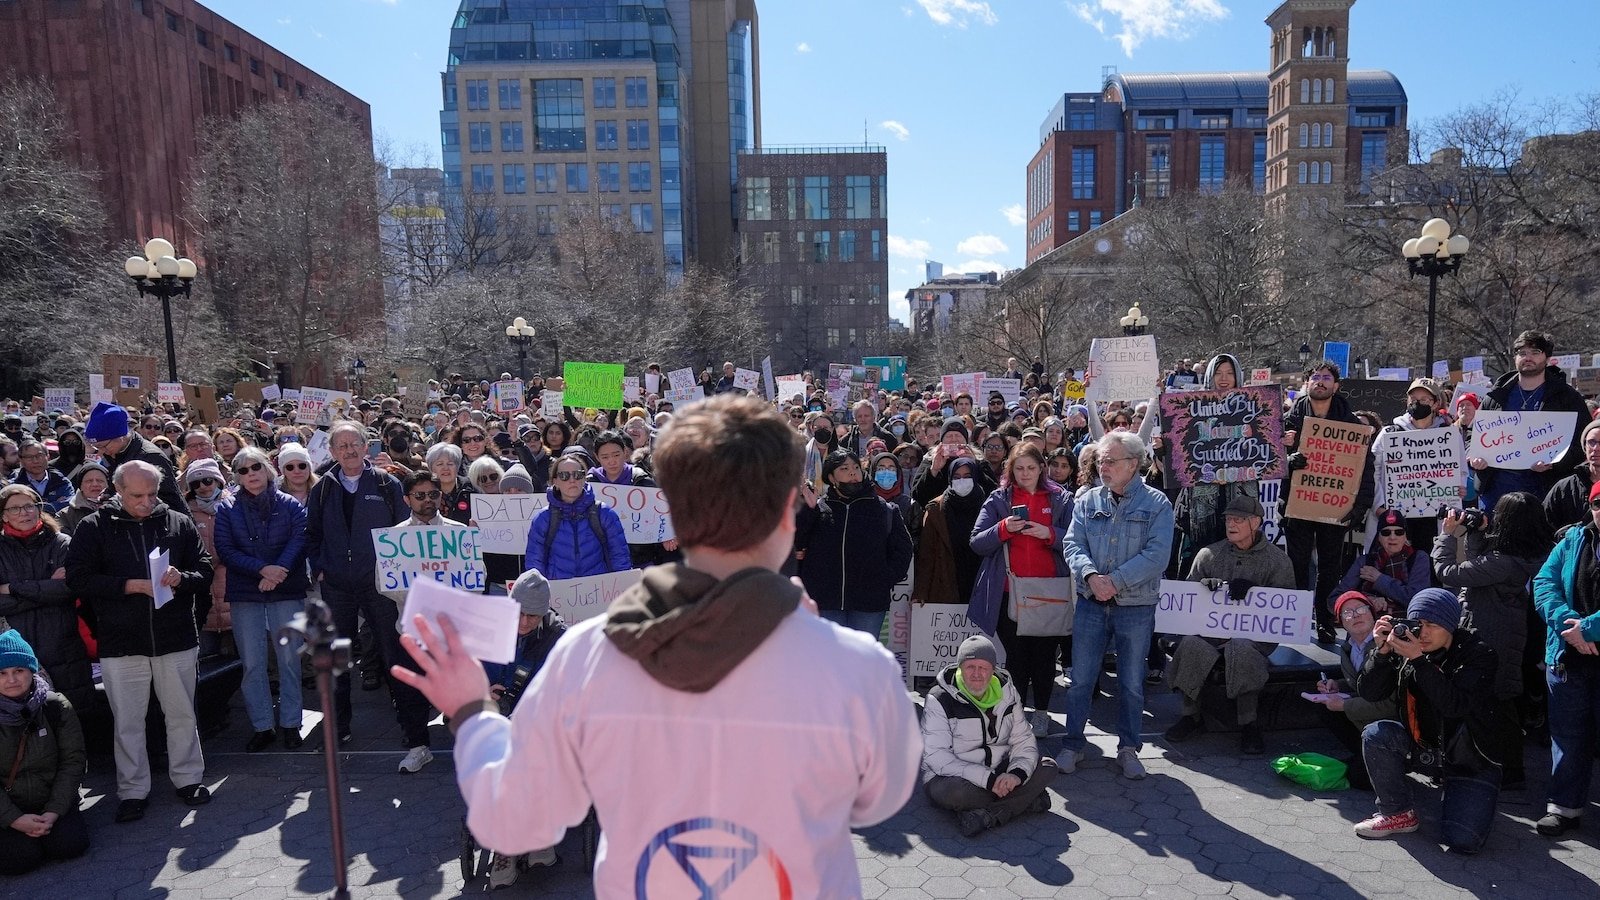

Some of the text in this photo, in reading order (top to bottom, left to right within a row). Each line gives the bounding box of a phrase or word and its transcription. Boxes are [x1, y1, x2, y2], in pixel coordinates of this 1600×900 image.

[1100, 350, 1152, 362] SCIENCE
[218, 401, 240, 411] FUND
[302, 400, 323, 410] NOT
[503, 400, 516, 408] NIH
[1188, 391, 1264, 423] United By
[1193, 417, 1253, 442] Nature
[1474, 411, 1522, 433] (Funding)
[1312, 423, 1320, 436] 9
[1323, 426, 1347, 441] OUT
[1347, 430, 1361, 443] OF
[1389, 436, 1399, 448] I
[1437, 431, 1452, 445] of
[1480, 421, 1554, 448] Cuts don't
[1188, 437, 1278, 470] Guided By
[1306, 437, 1361, 455] PREVENT
[1386, 446, 1452, 461] NO time in
[1495, 434, 1564, 464] cure cancer
[1198, 462, 1264, 484] Science
[1385, 460, 1460, 475] human where
[1396, 468, 1455, 482] IGNORANCE
[1300, 473, 1345, 490] PREFER
[1397, 481, 1423, 490] was
[1295, 489, 1350, 508] THE GOP
[1396, 485, 1461, 500] KNOWLEDGE
[475, 497, 543, 520] DATA
[377, 529, 484, 561] SCIENCE
[421, 560, 451, 572] NOT
[385, 570, 486, 590] SIENCE
[567, 582, 600, 608] Just
[1158, 592, 1198, 613] ONT
[931, 612, 968, 628] IF YOU
[893, 611, 909, 649] JUST
[933, 631, 959, 642] READ
[915, 660, 936, 672] THE
